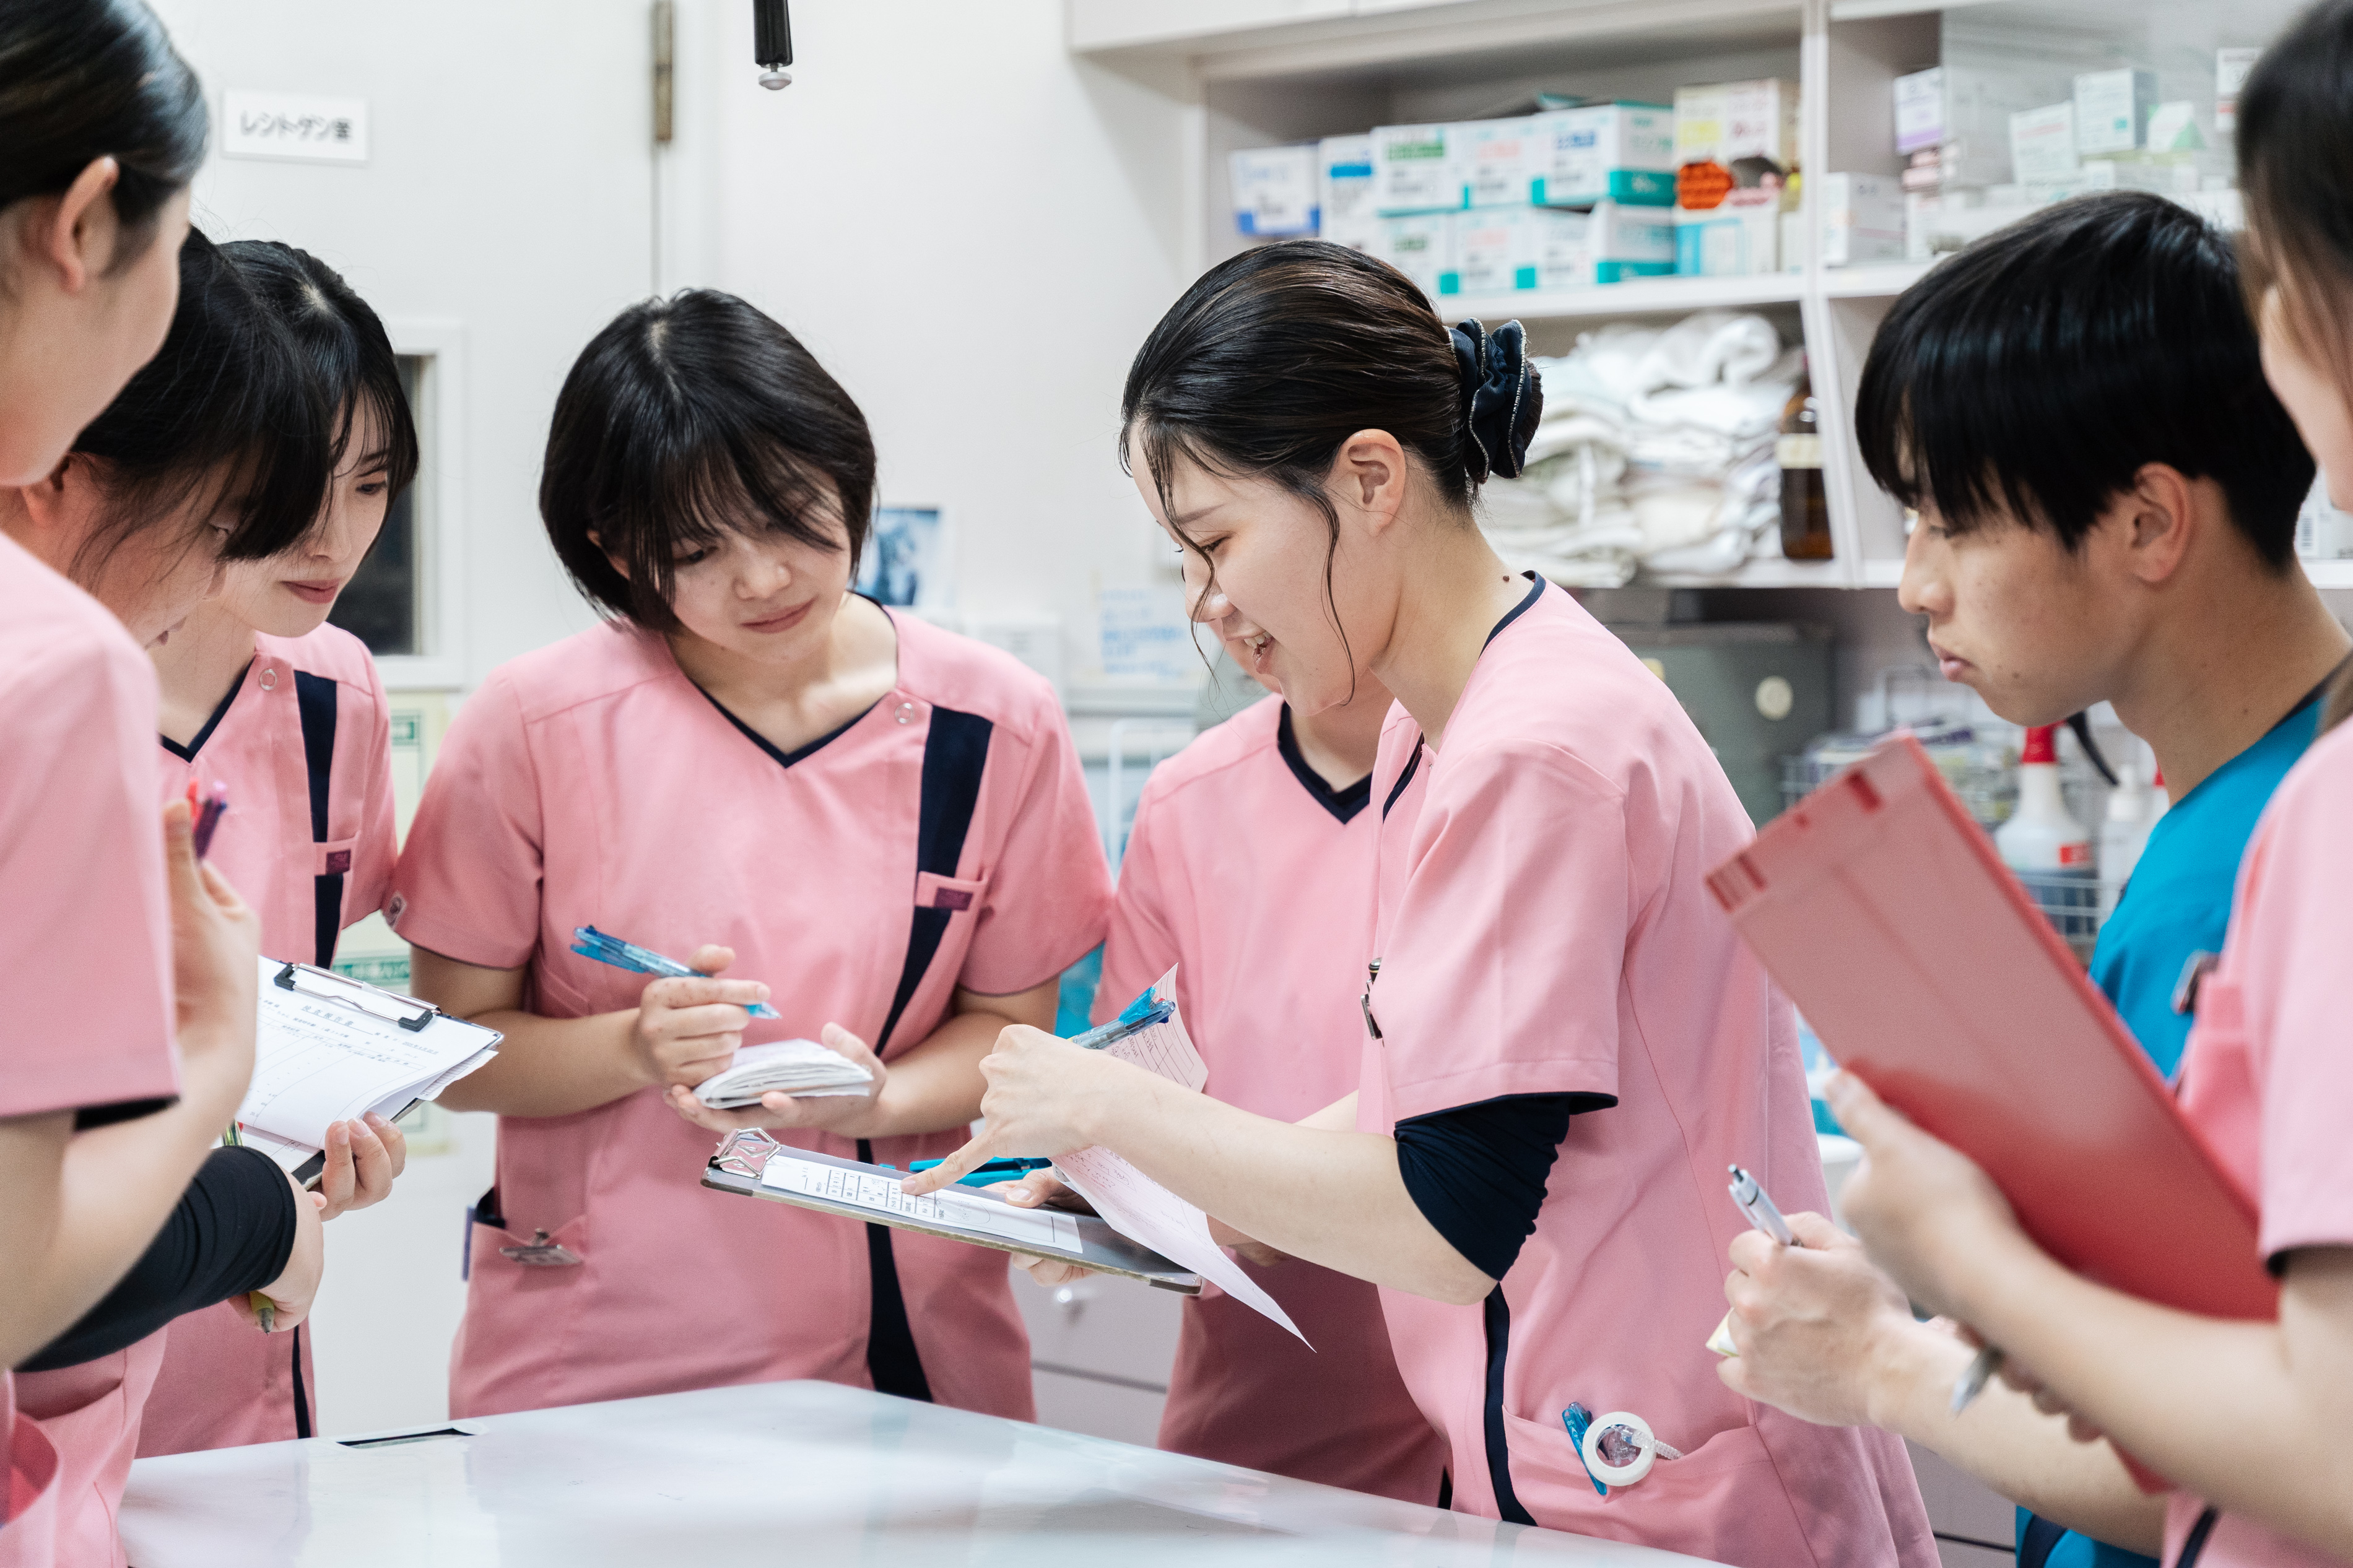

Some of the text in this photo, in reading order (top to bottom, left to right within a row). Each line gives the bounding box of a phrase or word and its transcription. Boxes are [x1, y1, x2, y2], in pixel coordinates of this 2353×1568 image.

[240, 110, 352, 143] レントゲン室
